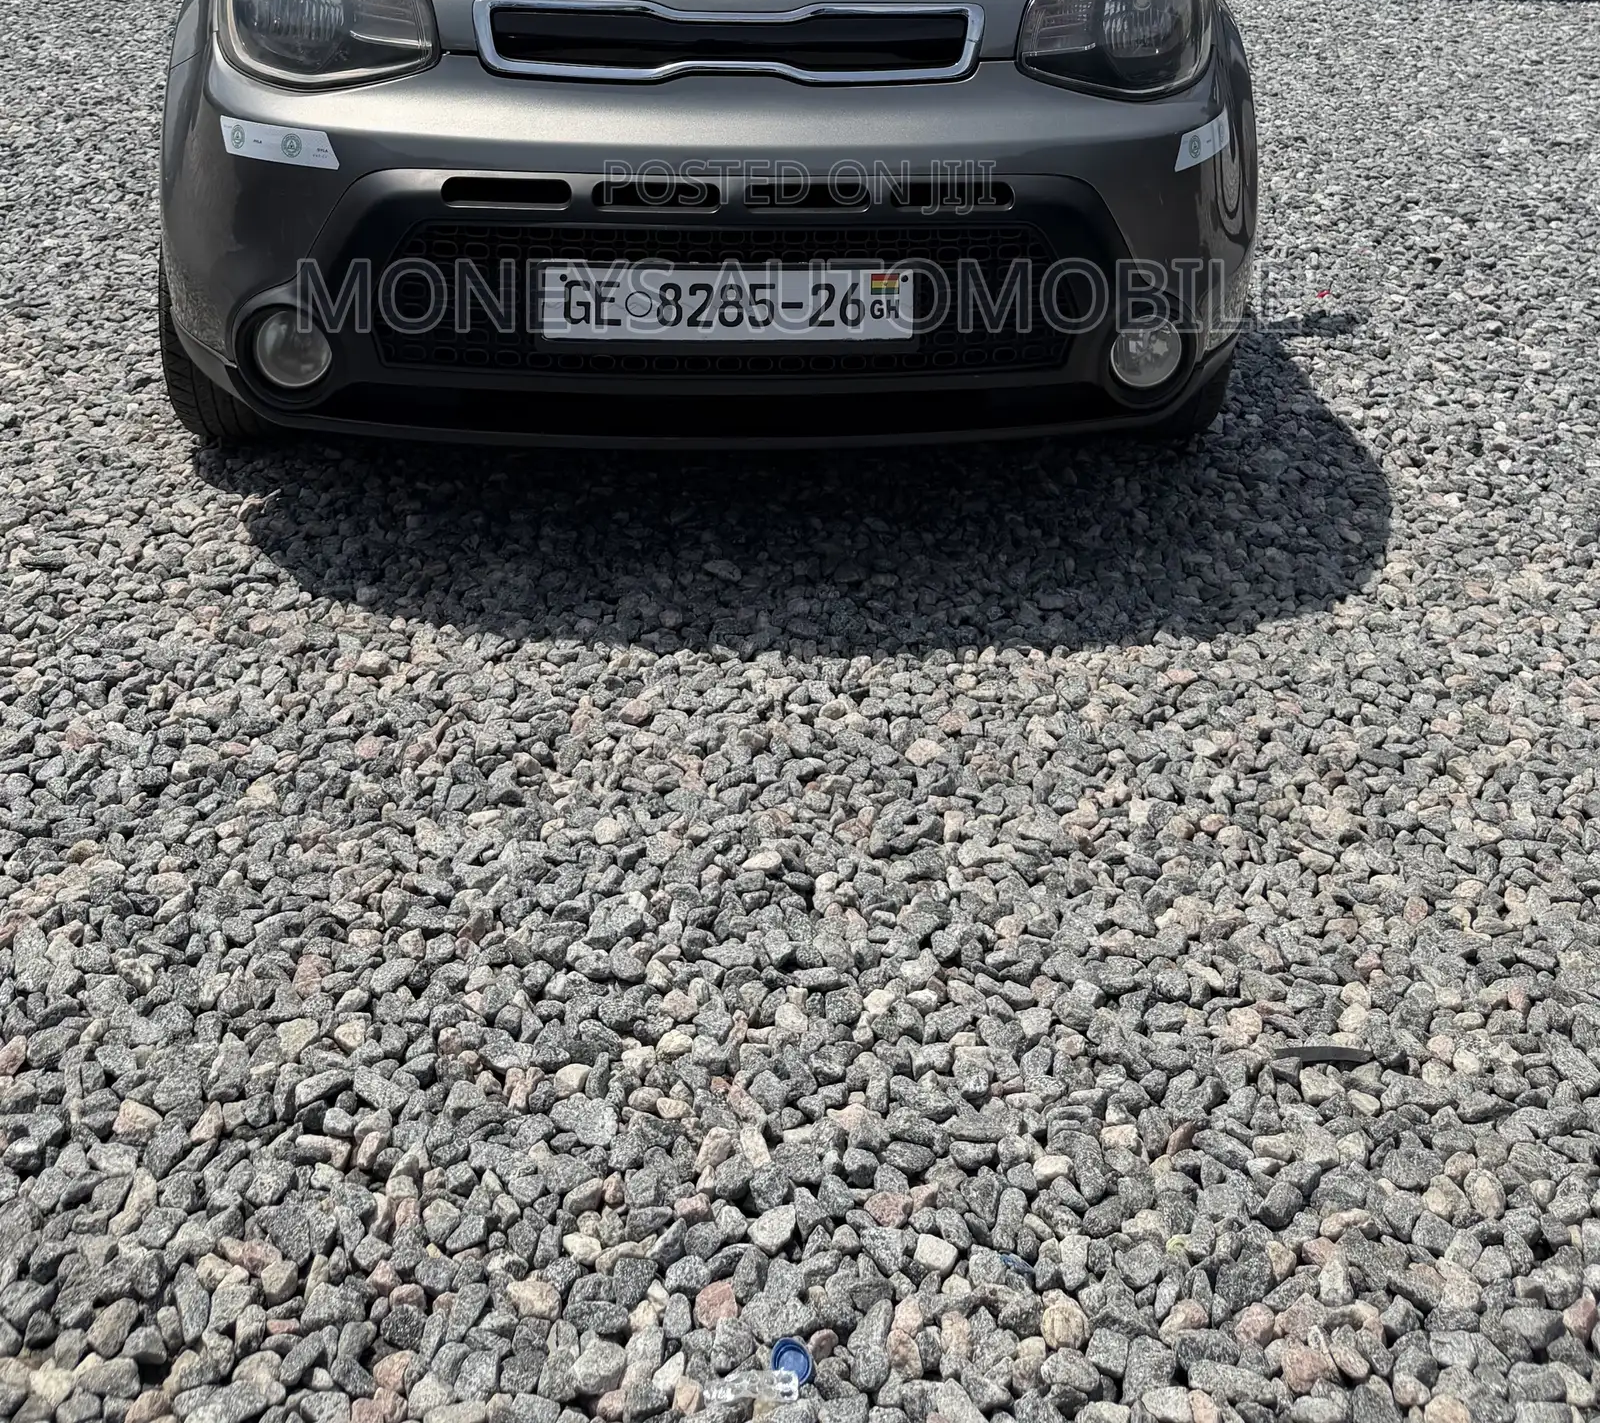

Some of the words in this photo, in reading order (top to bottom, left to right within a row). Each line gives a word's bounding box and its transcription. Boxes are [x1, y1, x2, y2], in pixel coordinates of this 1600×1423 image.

[562, 280, 623, 328] GE
[656, 282, 868, 329] 8285-26
[868, 298, 901, 321] GH
